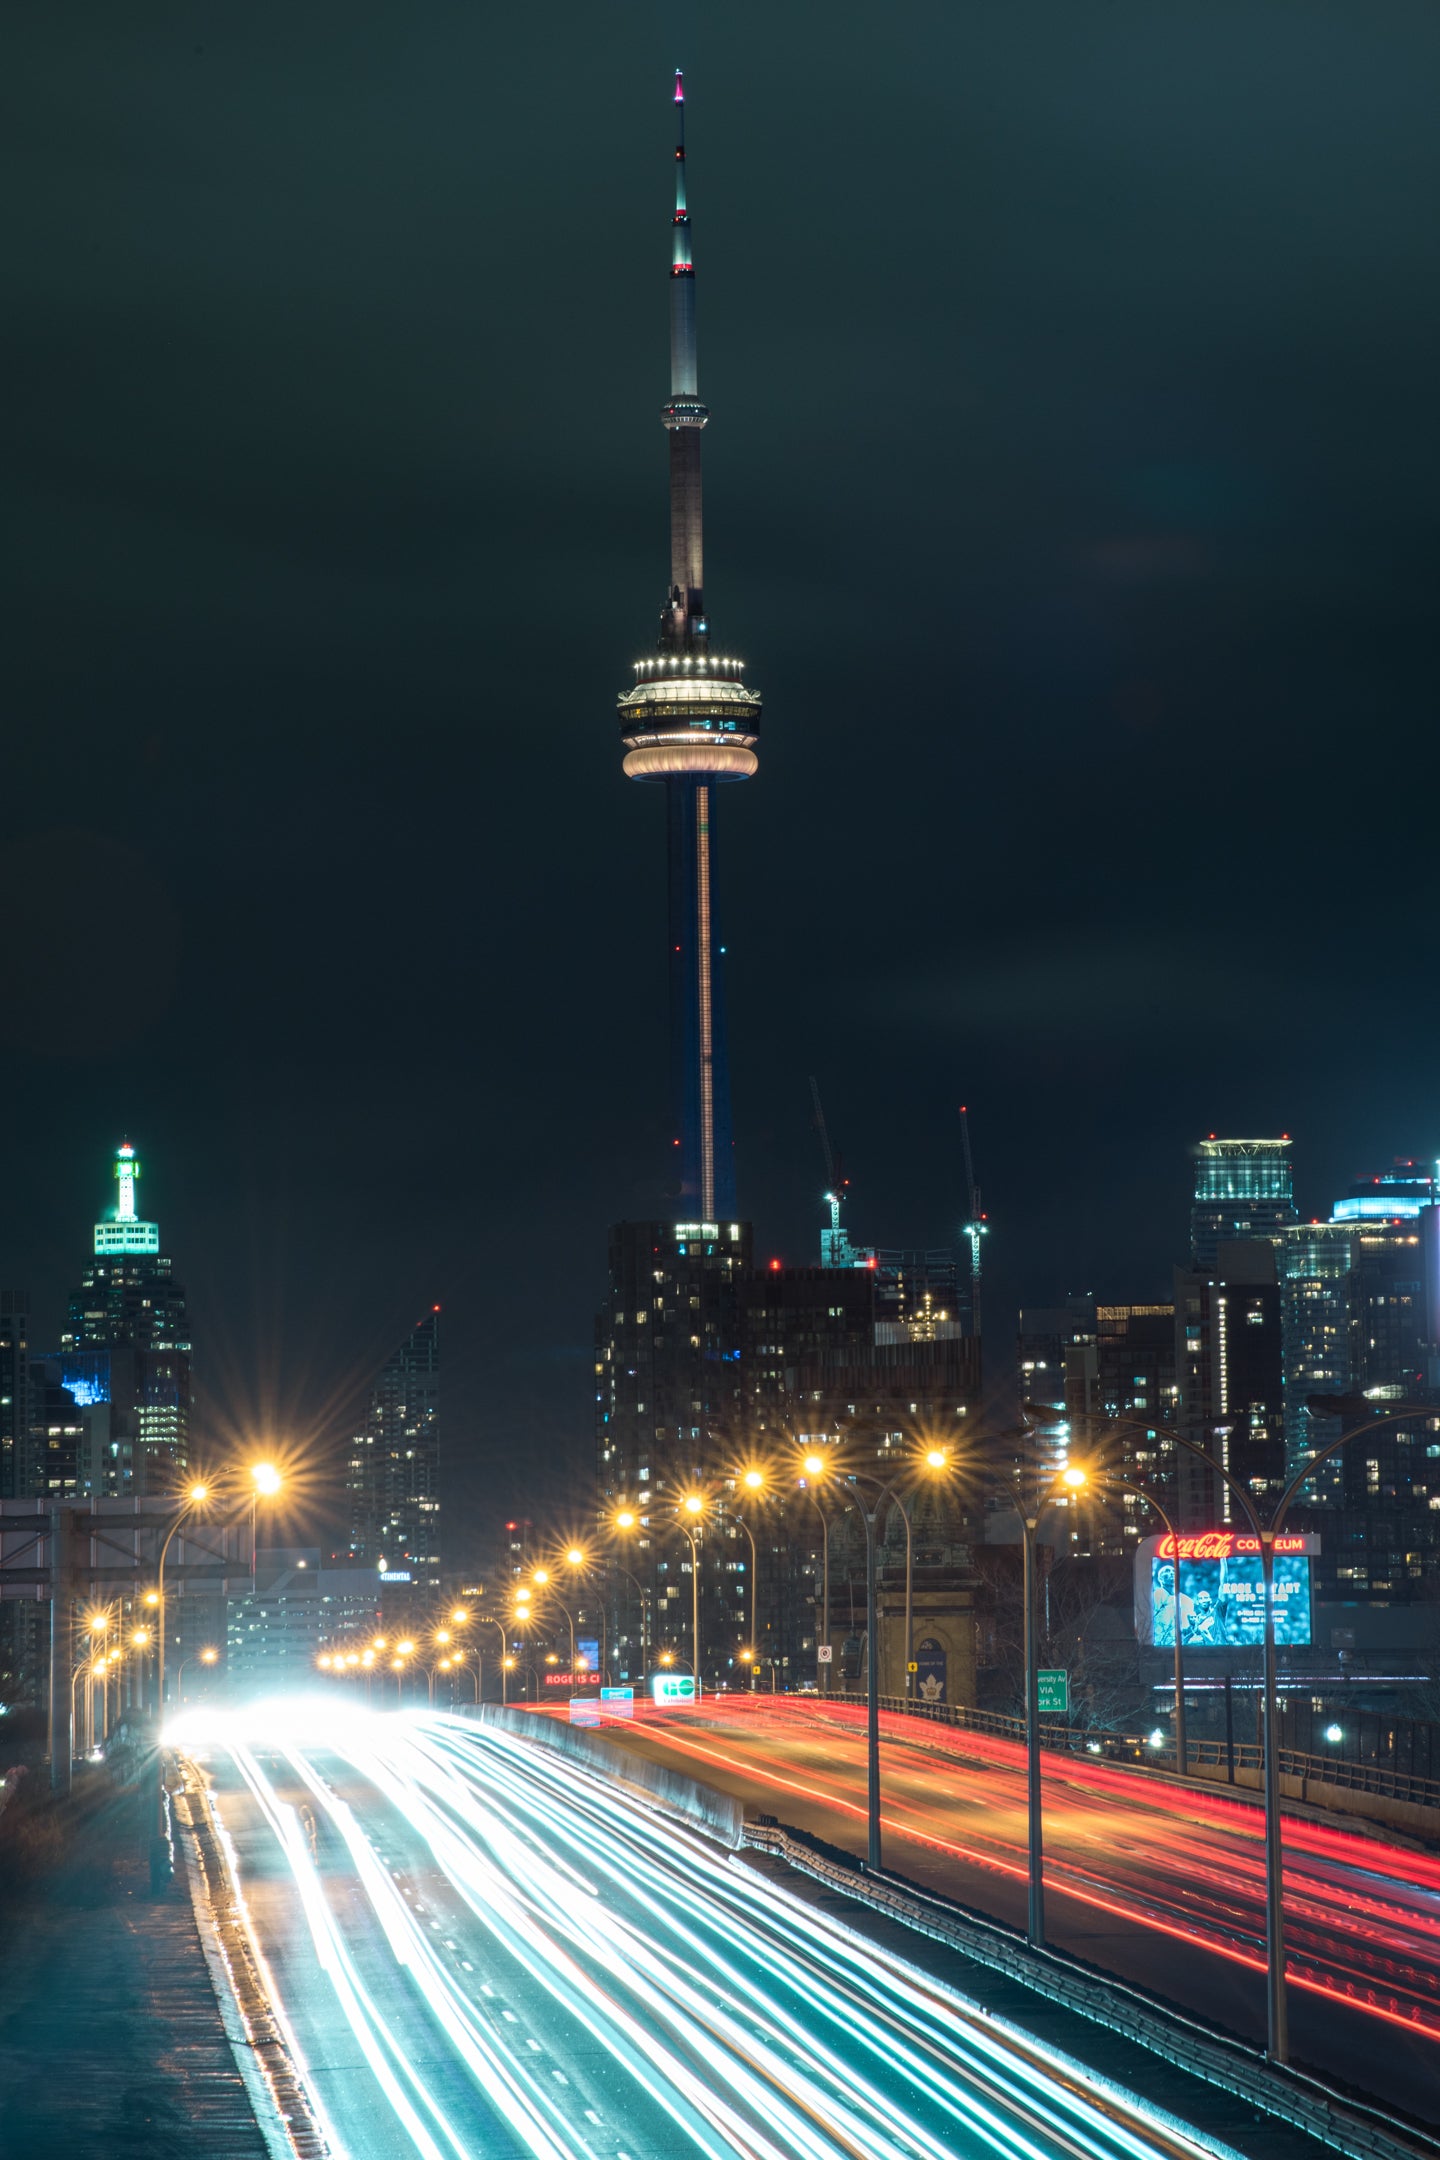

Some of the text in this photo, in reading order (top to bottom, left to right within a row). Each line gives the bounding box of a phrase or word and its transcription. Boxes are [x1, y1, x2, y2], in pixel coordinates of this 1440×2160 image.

[1236, 1539, 1303, 1550] COLEUM
[1256, 1582, 1301, 1594] BYANT
[1039, 1686, 1054, 1694] VIA
[1052, 1697, 1062, 1706] St
